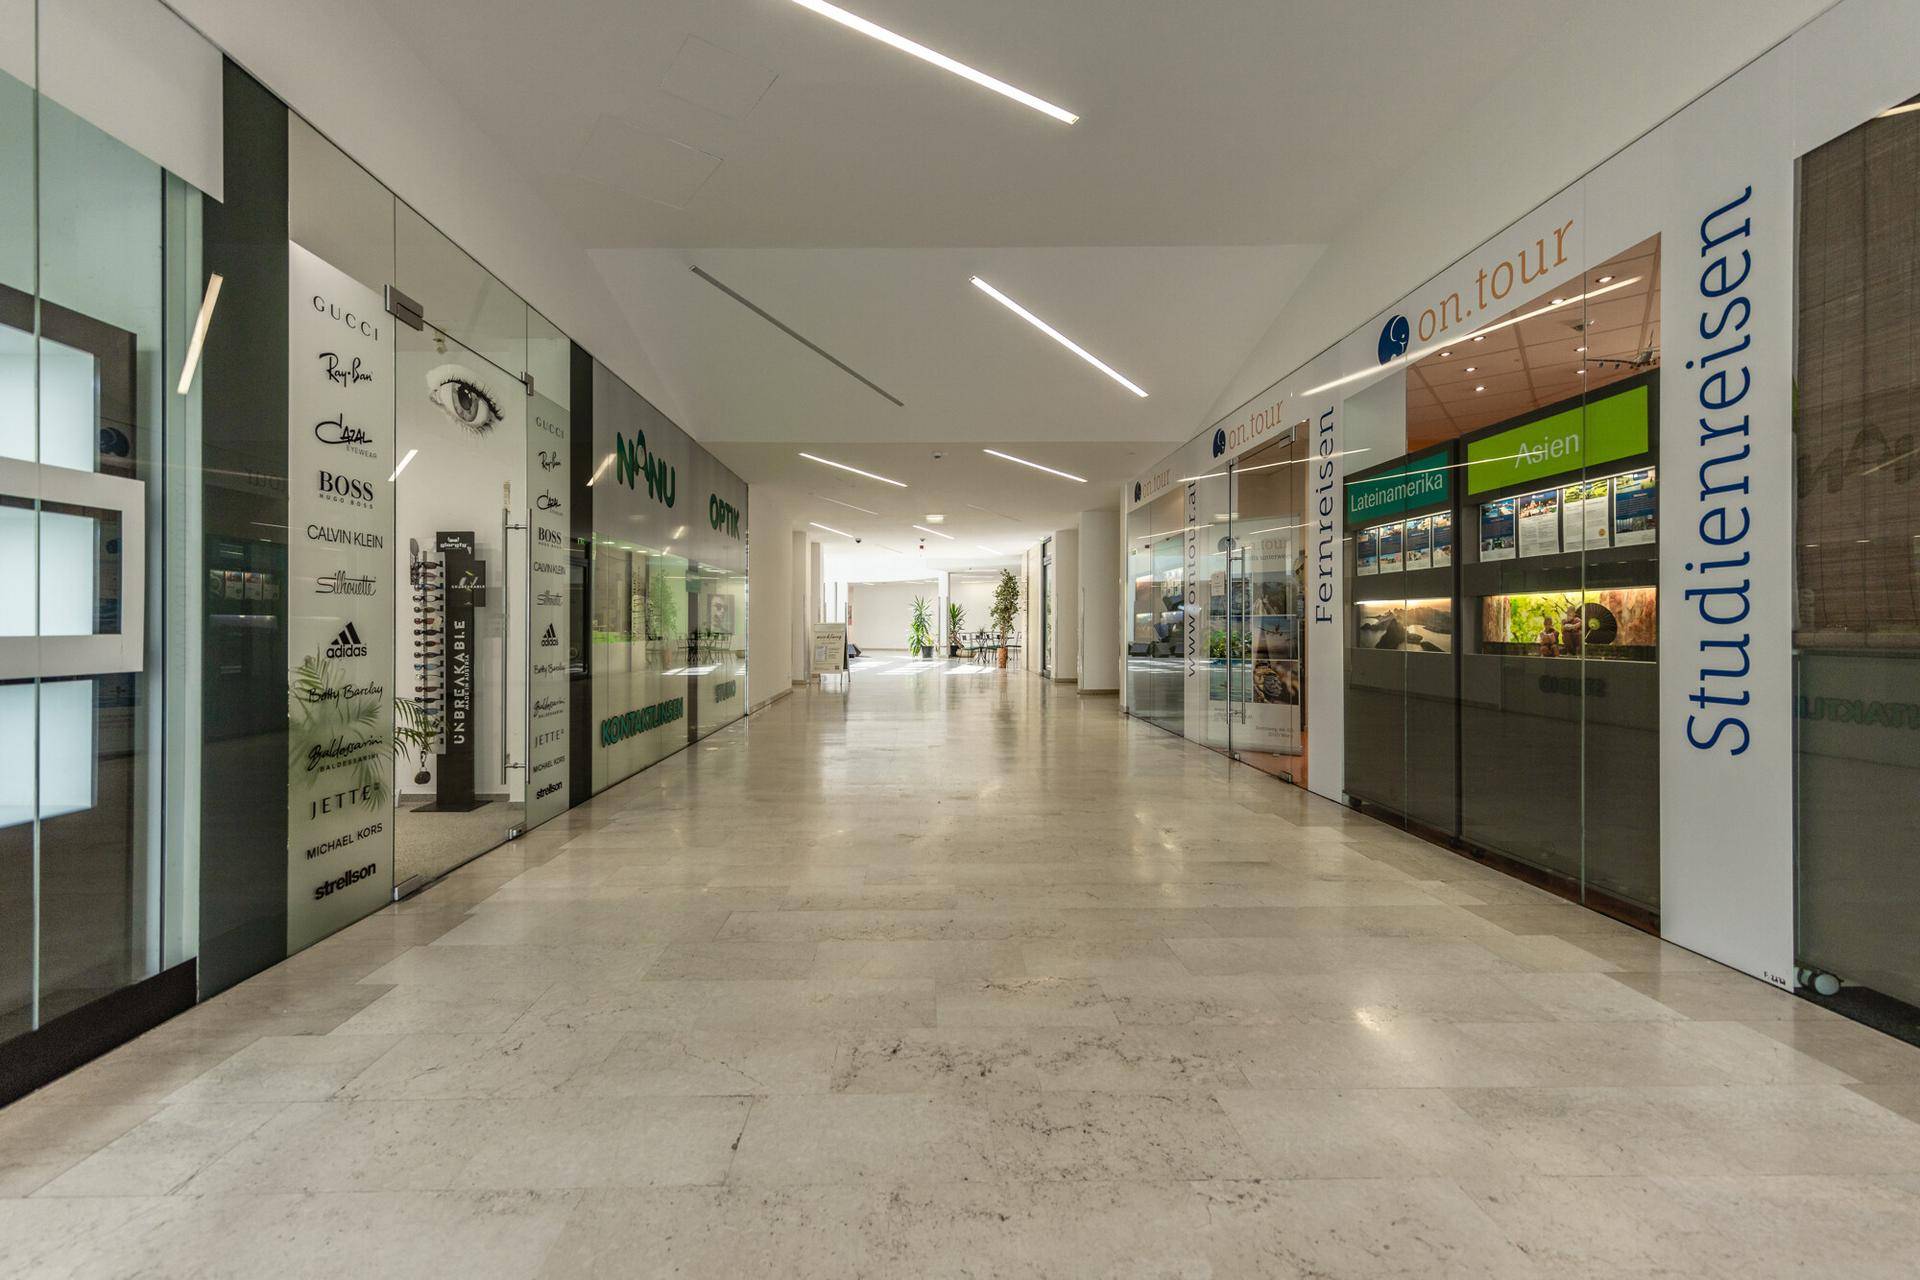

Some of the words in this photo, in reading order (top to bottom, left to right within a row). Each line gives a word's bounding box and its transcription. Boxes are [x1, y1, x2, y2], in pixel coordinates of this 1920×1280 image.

[1418, 219, 1574, 342] on.tour
[313, 295, 378, 341] GUCCI
[536, 416, 564, 439] GUCCI
[1229, 400, 1284, 449] on.tour
[616, 429, 675, 508] NANU
[1515, 432, 1580, 469] Asien
[319, 470, 374, 501] BOSS
[1685, 185, 1752, 756] Studienreisen
[1350, 471, 1443, 512] Lateinamerika
[709, 493, 740, 540] OPTIK
[1316, 406, 1335, 624] Fernreisen
[307, 524, 352, 545] CALVIN
[353, 531, 383, 549] KLEIN
[538, 527, 562, 545] BOSS
[315, 570, 377, 597] Silhouette
[1188, 479, 1196, 677] wwwontour.at
[326, 645, 368, 659] adidas
[343, 681, 383, 703] Barclay
[601, 696, 684, 749] KONTAKTLINSEN
[311, 784, 372, 820] JETTE
[306, 834, 354, 861] MICHAEL
[357, 822, 384, 841] KORS
[315, 863, 377, 901] strellson
